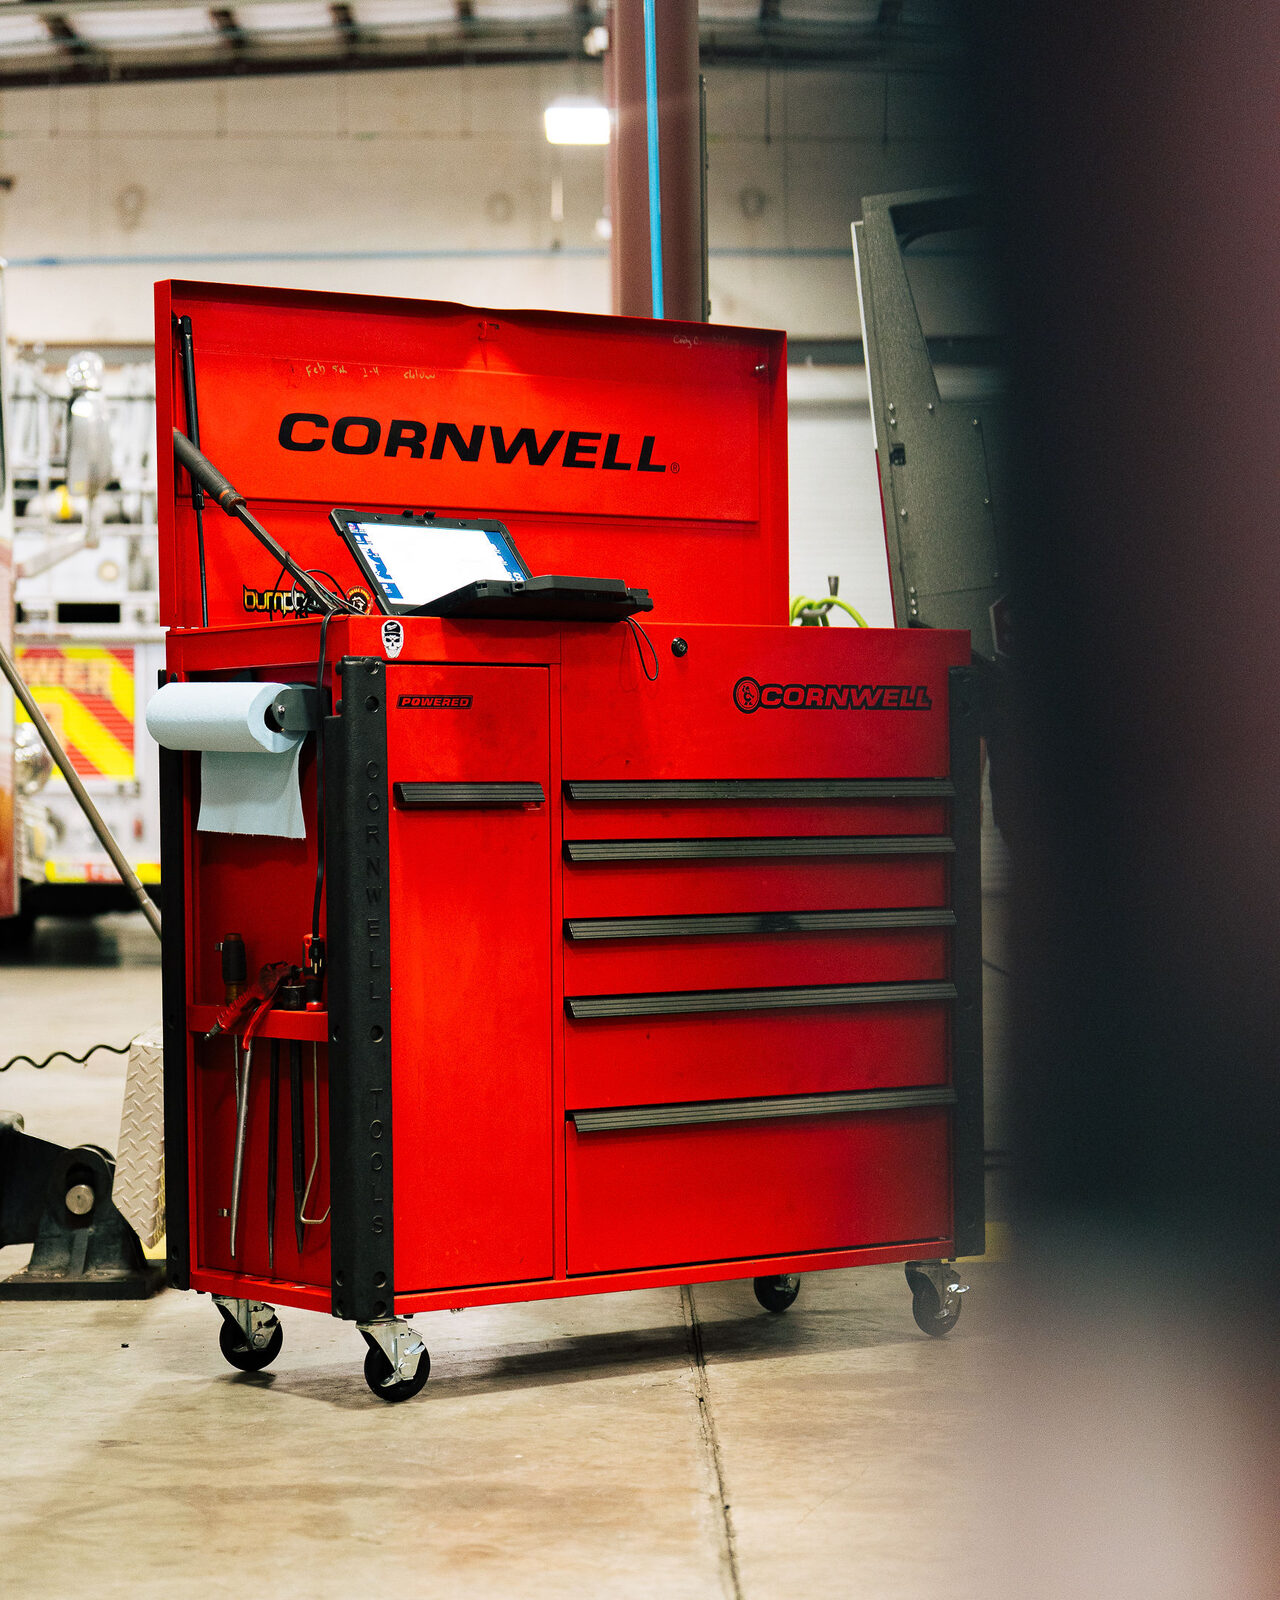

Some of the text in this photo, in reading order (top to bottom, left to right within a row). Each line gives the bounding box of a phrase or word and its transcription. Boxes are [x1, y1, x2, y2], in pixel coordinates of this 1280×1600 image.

[278, 412, 667, 473] CORNWELL
[400, 697, 470, 707] POWERED
[760, 683, 932, 711] CORNWELL
[365, 759, 382, 1000] CORNWELL
[369, 1087, 384, 1233] TOOLS
